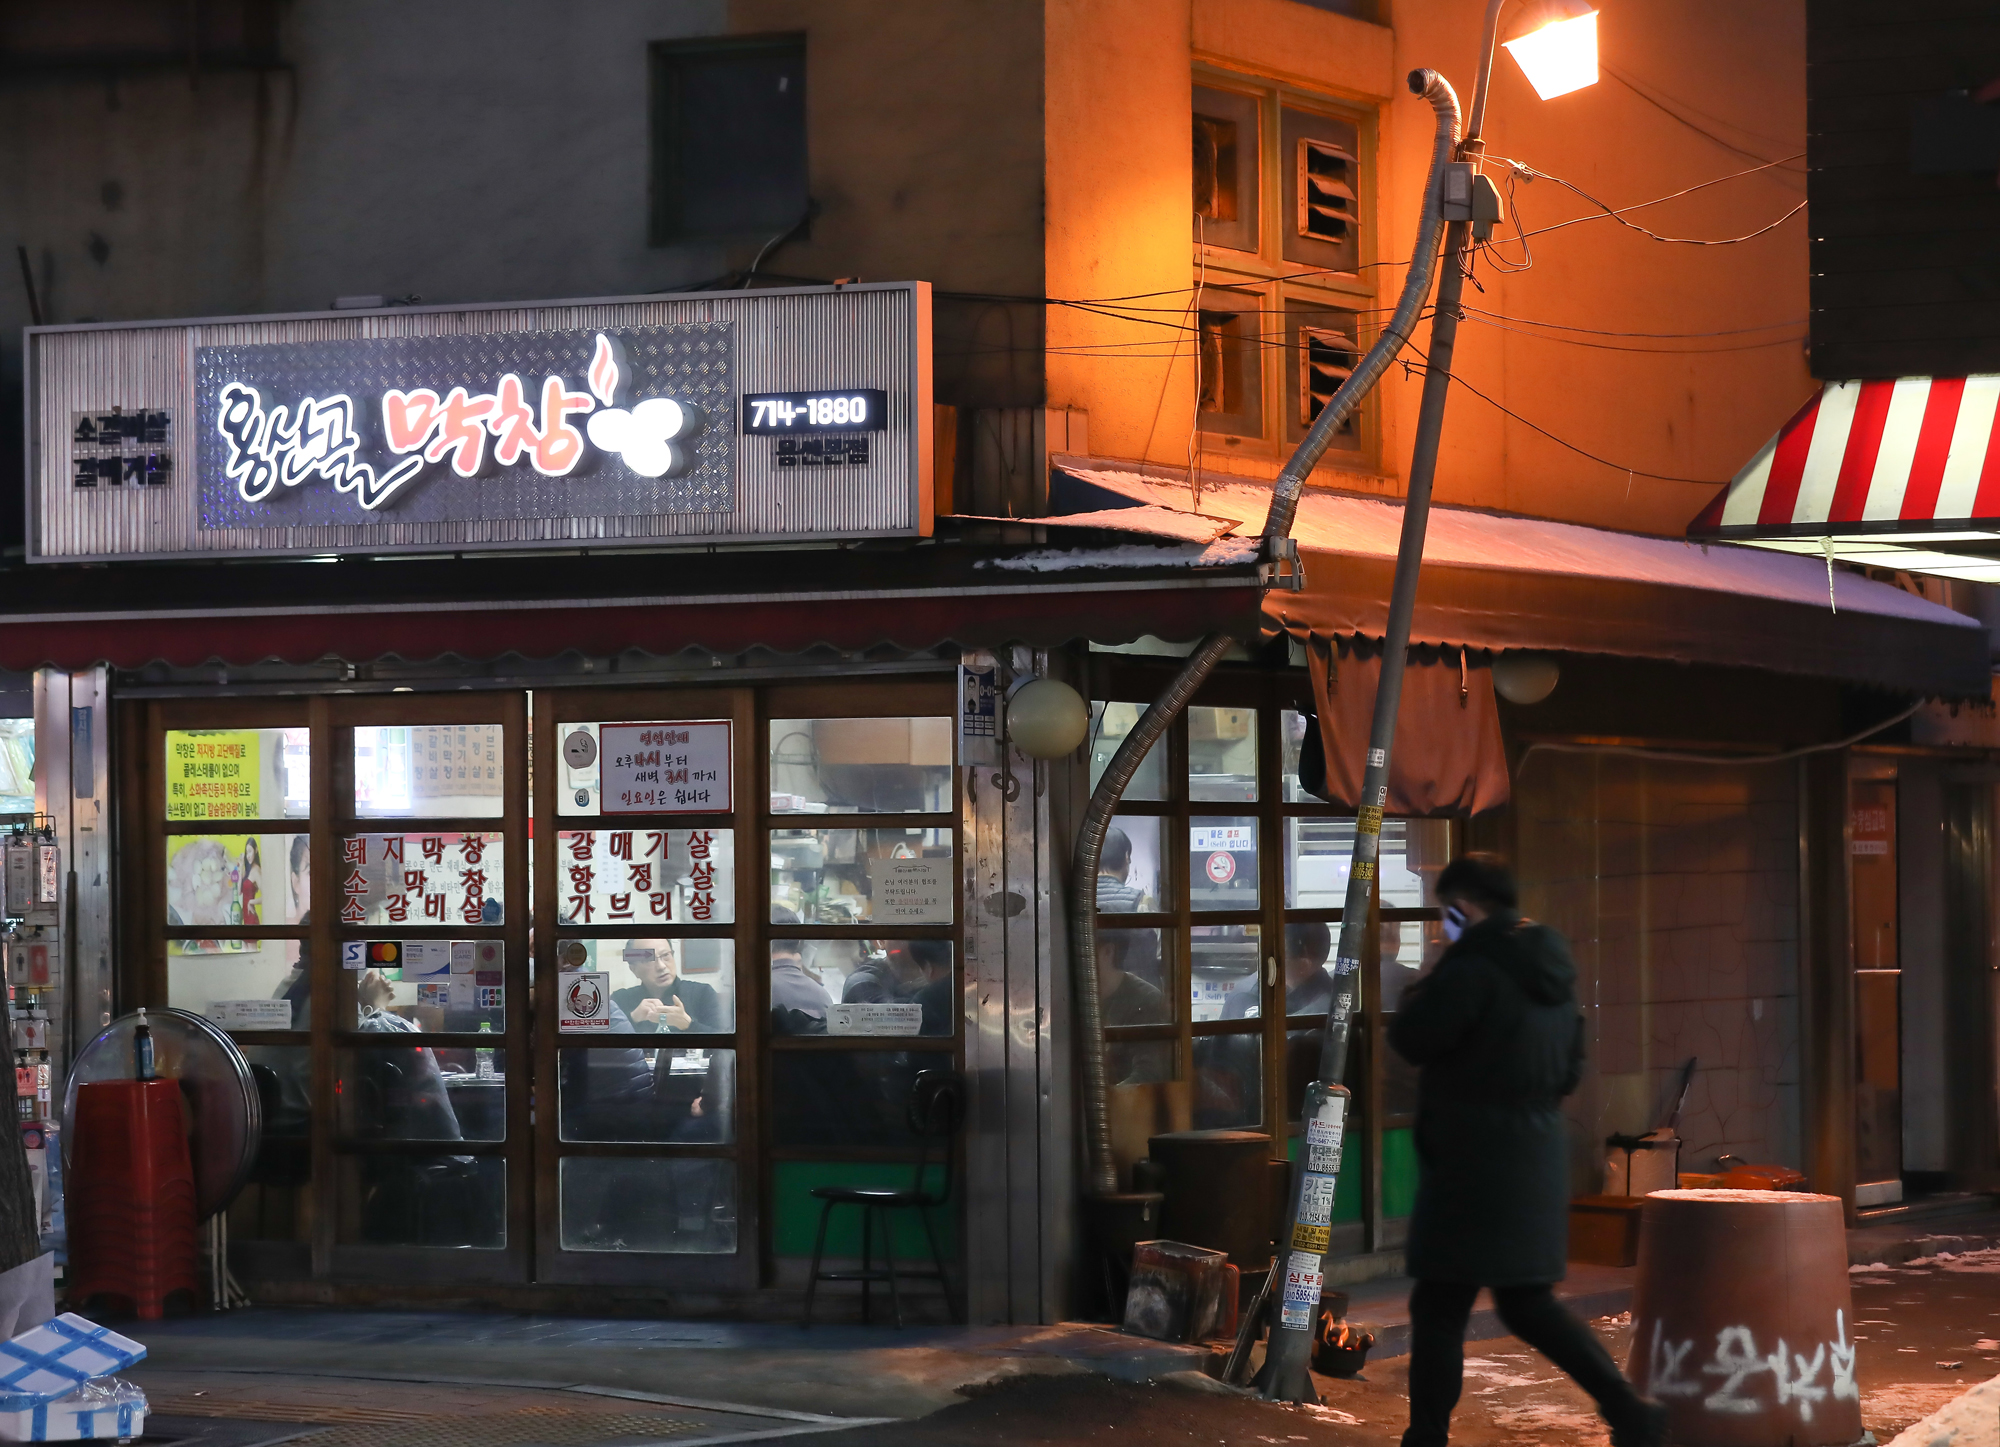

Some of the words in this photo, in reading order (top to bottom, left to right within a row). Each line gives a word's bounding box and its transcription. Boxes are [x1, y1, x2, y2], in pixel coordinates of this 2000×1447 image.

[750, 397, 867, 427] 714-1880
[383, 373, 596, 477] 막창
[639, 730, 690, 746] 영업안내
[635, 770, 659, 783] 새벽
[692, 770, 717, 781] 까지
[621, 789, 667, 806] 일요일은
[674, 788, 711, 805] 쉽니다
[1311, 1120, 1326, 1129] 카드
[1304, 1178, 1333, 1195] 카드
